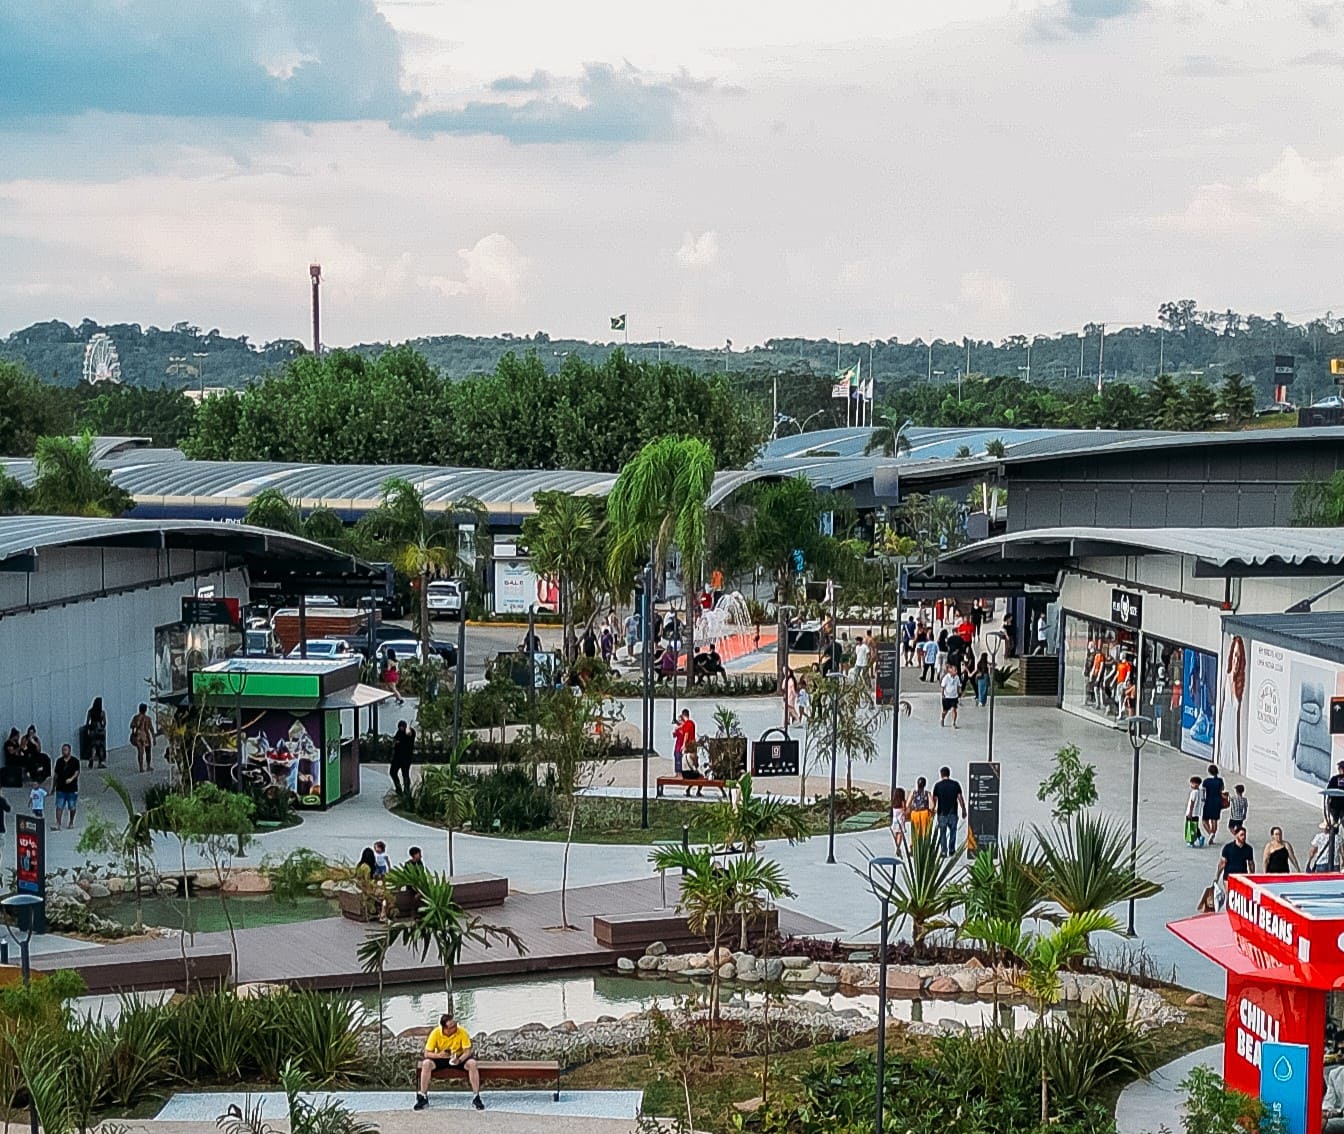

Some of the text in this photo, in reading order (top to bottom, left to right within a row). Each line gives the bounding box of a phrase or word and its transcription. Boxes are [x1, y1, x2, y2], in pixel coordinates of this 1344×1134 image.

[1228, 889, 1293, 946] CHILLI BEANS
[1239, 998, 1280, 1043] CHILLI
[1237, 1027, 1262, 1071] BEA
